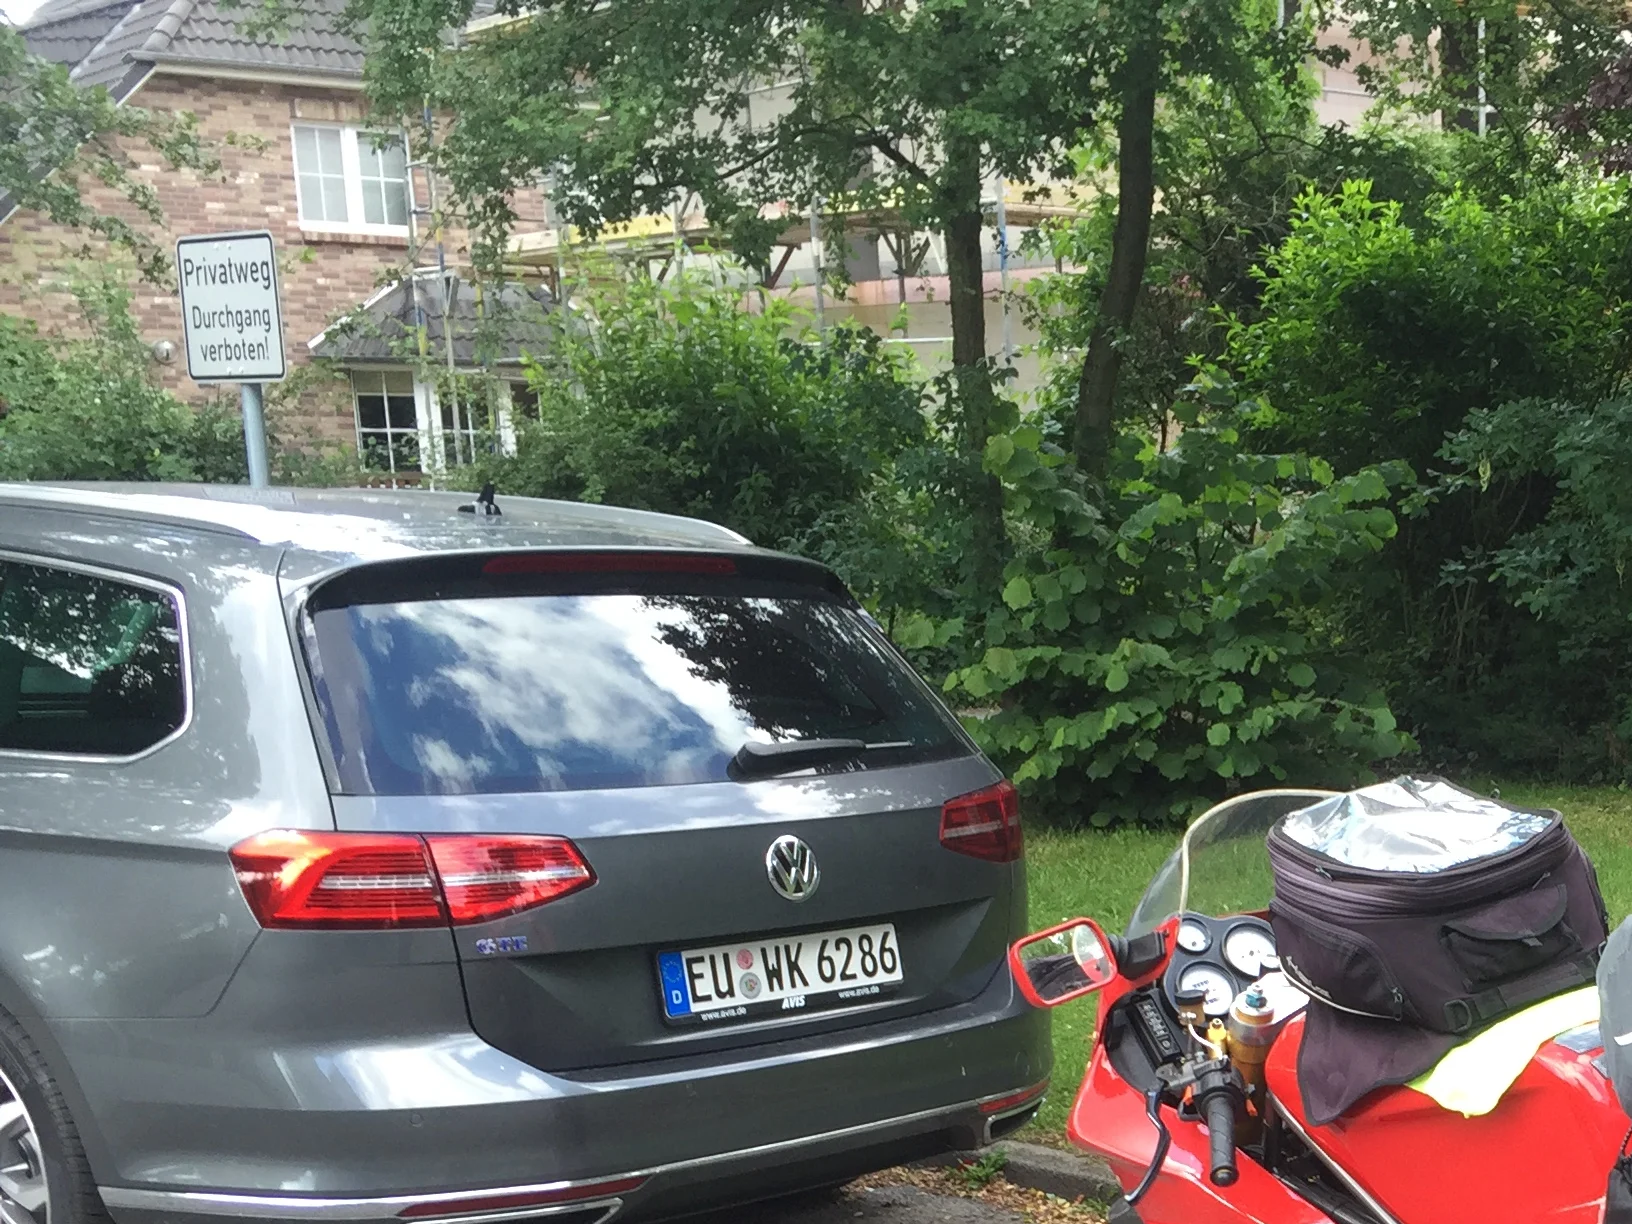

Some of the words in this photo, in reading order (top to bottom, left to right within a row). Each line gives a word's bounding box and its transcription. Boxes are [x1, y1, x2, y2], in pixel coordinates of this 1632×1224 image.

[183, 257, 272, 291] Privatweg
[192, 304, 272, 334] Durchgang
[200, 336, 270, 362] verboten!
[685, 952, 736, 1004] EU
[760, 941, 810, 994] WK
[817, 930, 898, 984] 6286
[671, 989, 683, 1005] D
[781, 995, 806, 1010] AVIS
[701, 1007, 747, 1021] www.avis.de
